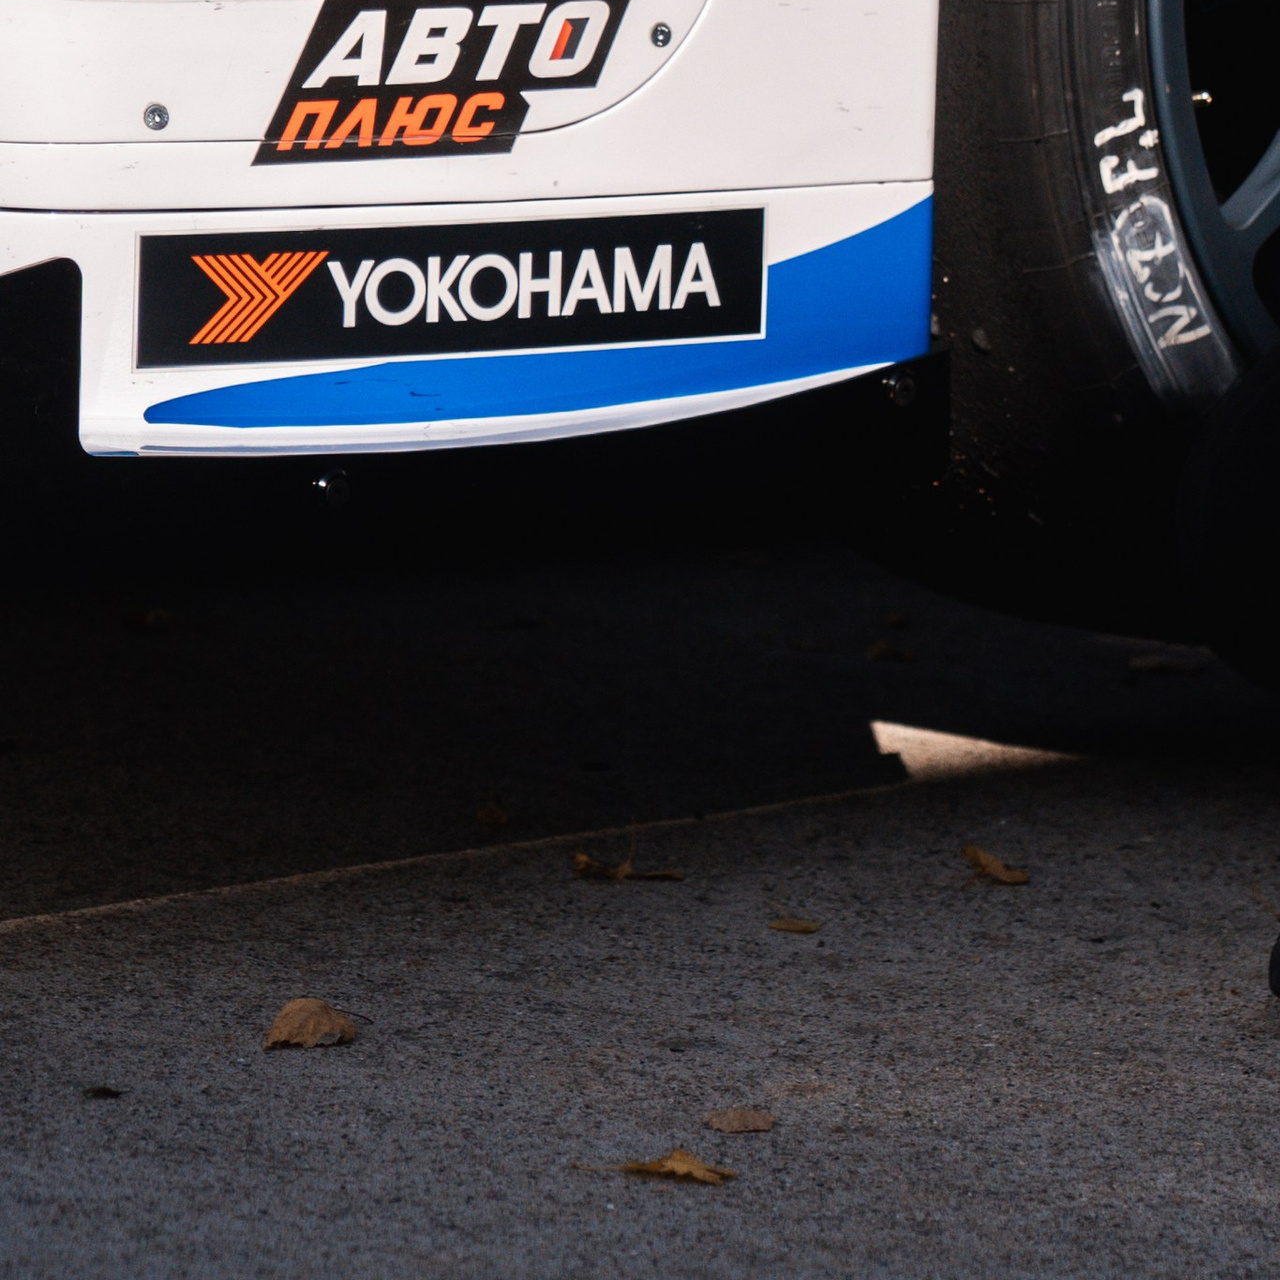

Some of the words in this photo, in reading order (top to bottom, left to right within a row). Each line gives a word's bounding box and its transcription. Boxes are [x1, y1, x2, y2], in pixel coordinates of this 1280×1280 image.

[301, 0, 612, 89] АВТО
[276, 92, 506, 152] ПЛЮС
[326, 241, 722, 329] YOKOHAMA
